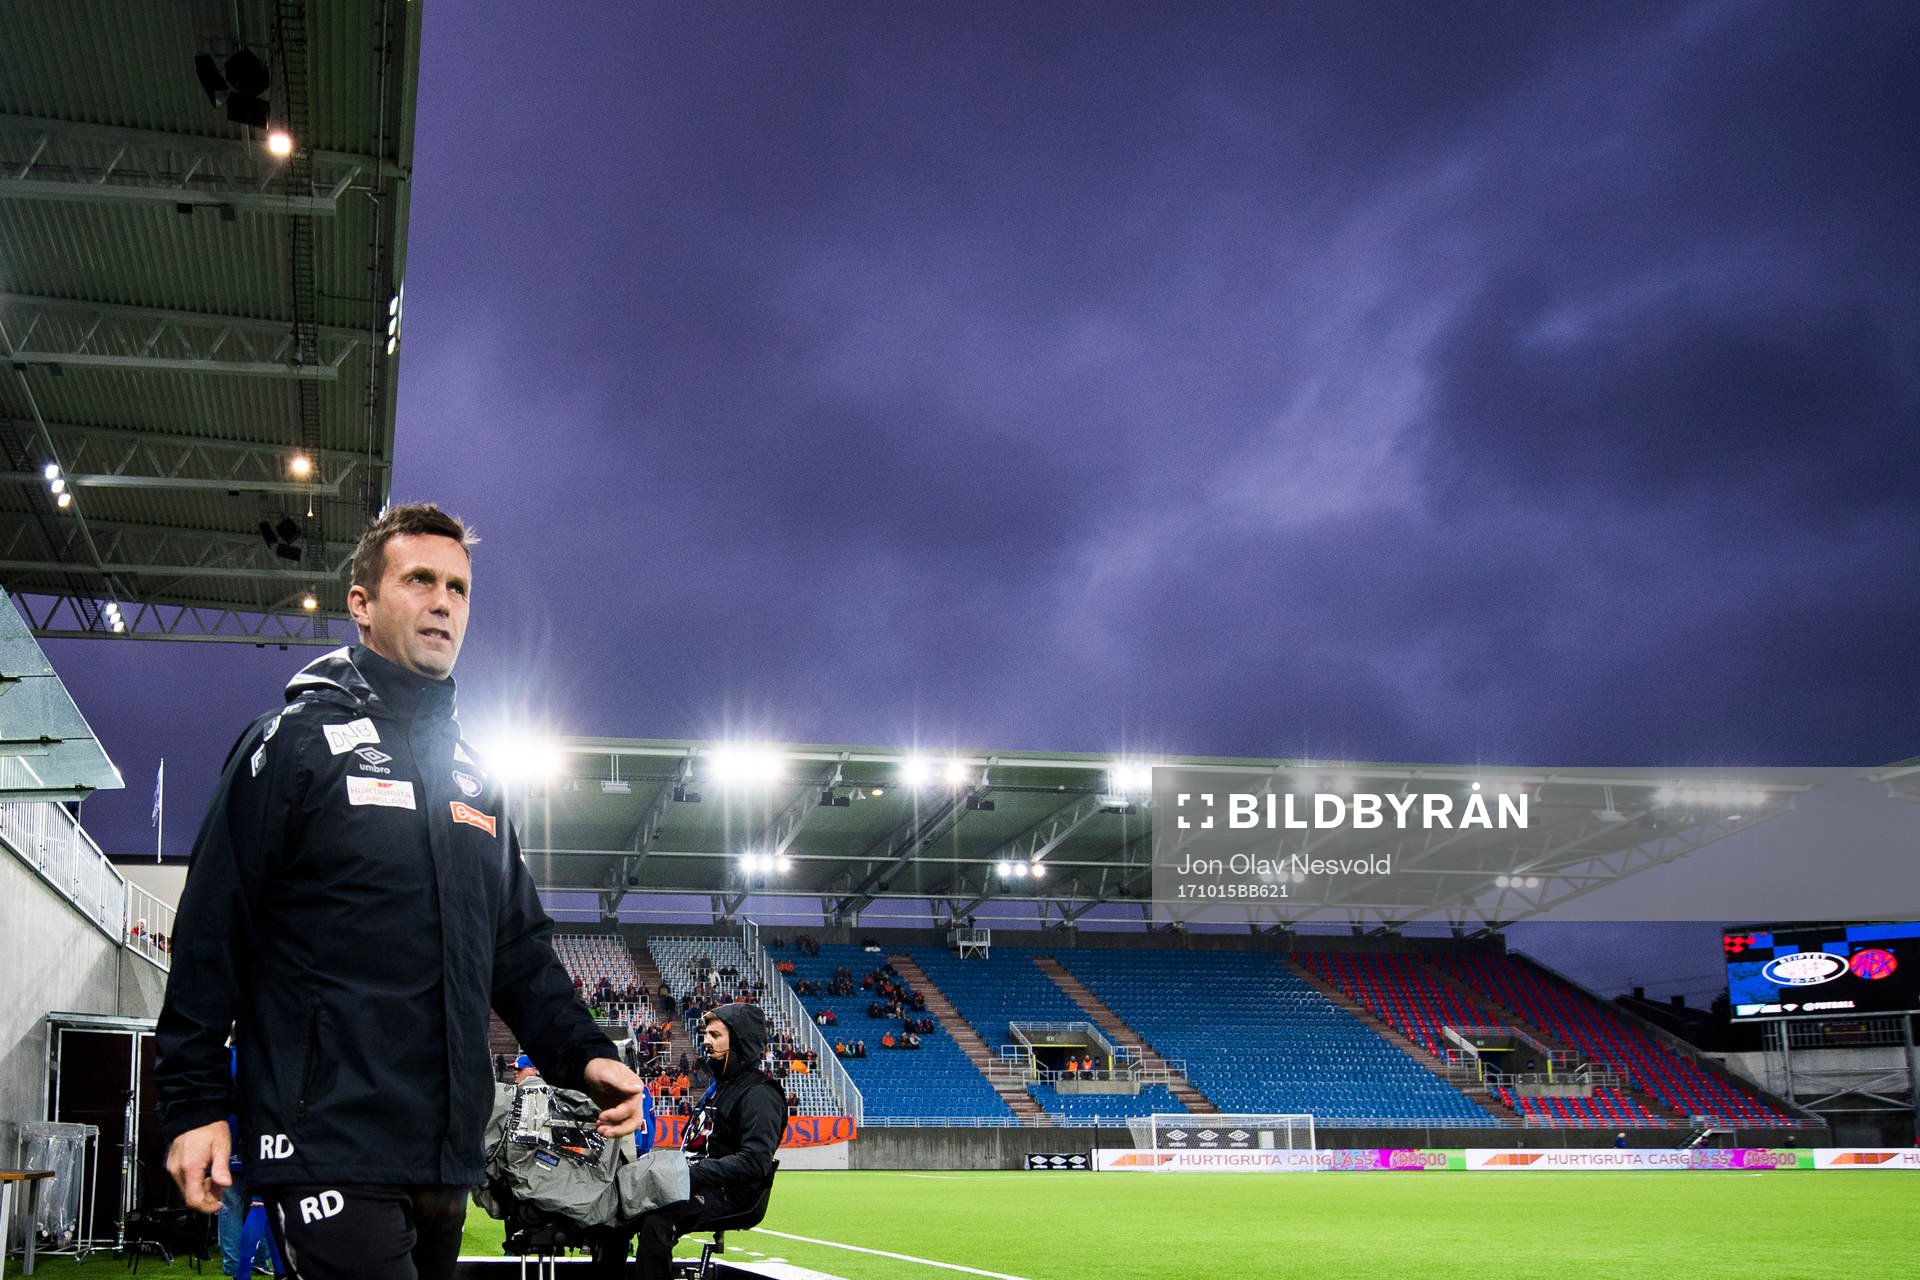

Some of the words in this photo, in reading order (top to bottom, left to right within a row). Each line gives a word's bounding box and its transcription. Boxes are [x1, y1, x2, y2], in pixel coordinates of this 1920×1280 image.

[331, 723, 373, 749] DNB
[359, 763, 391, 774] umbro
[259, 1133, 295, 1160] RD
[1179, 1154, 1283, 1166] HURTIGRUTA
[1287, 1154, 1374, 1166] CARGLASS
[1546, 1153, 1644, 1165] HURTIGRUTA
[1647, 1153, 1730, 1165] CARGLASS
[299, 1190, 345, 1225] RD
